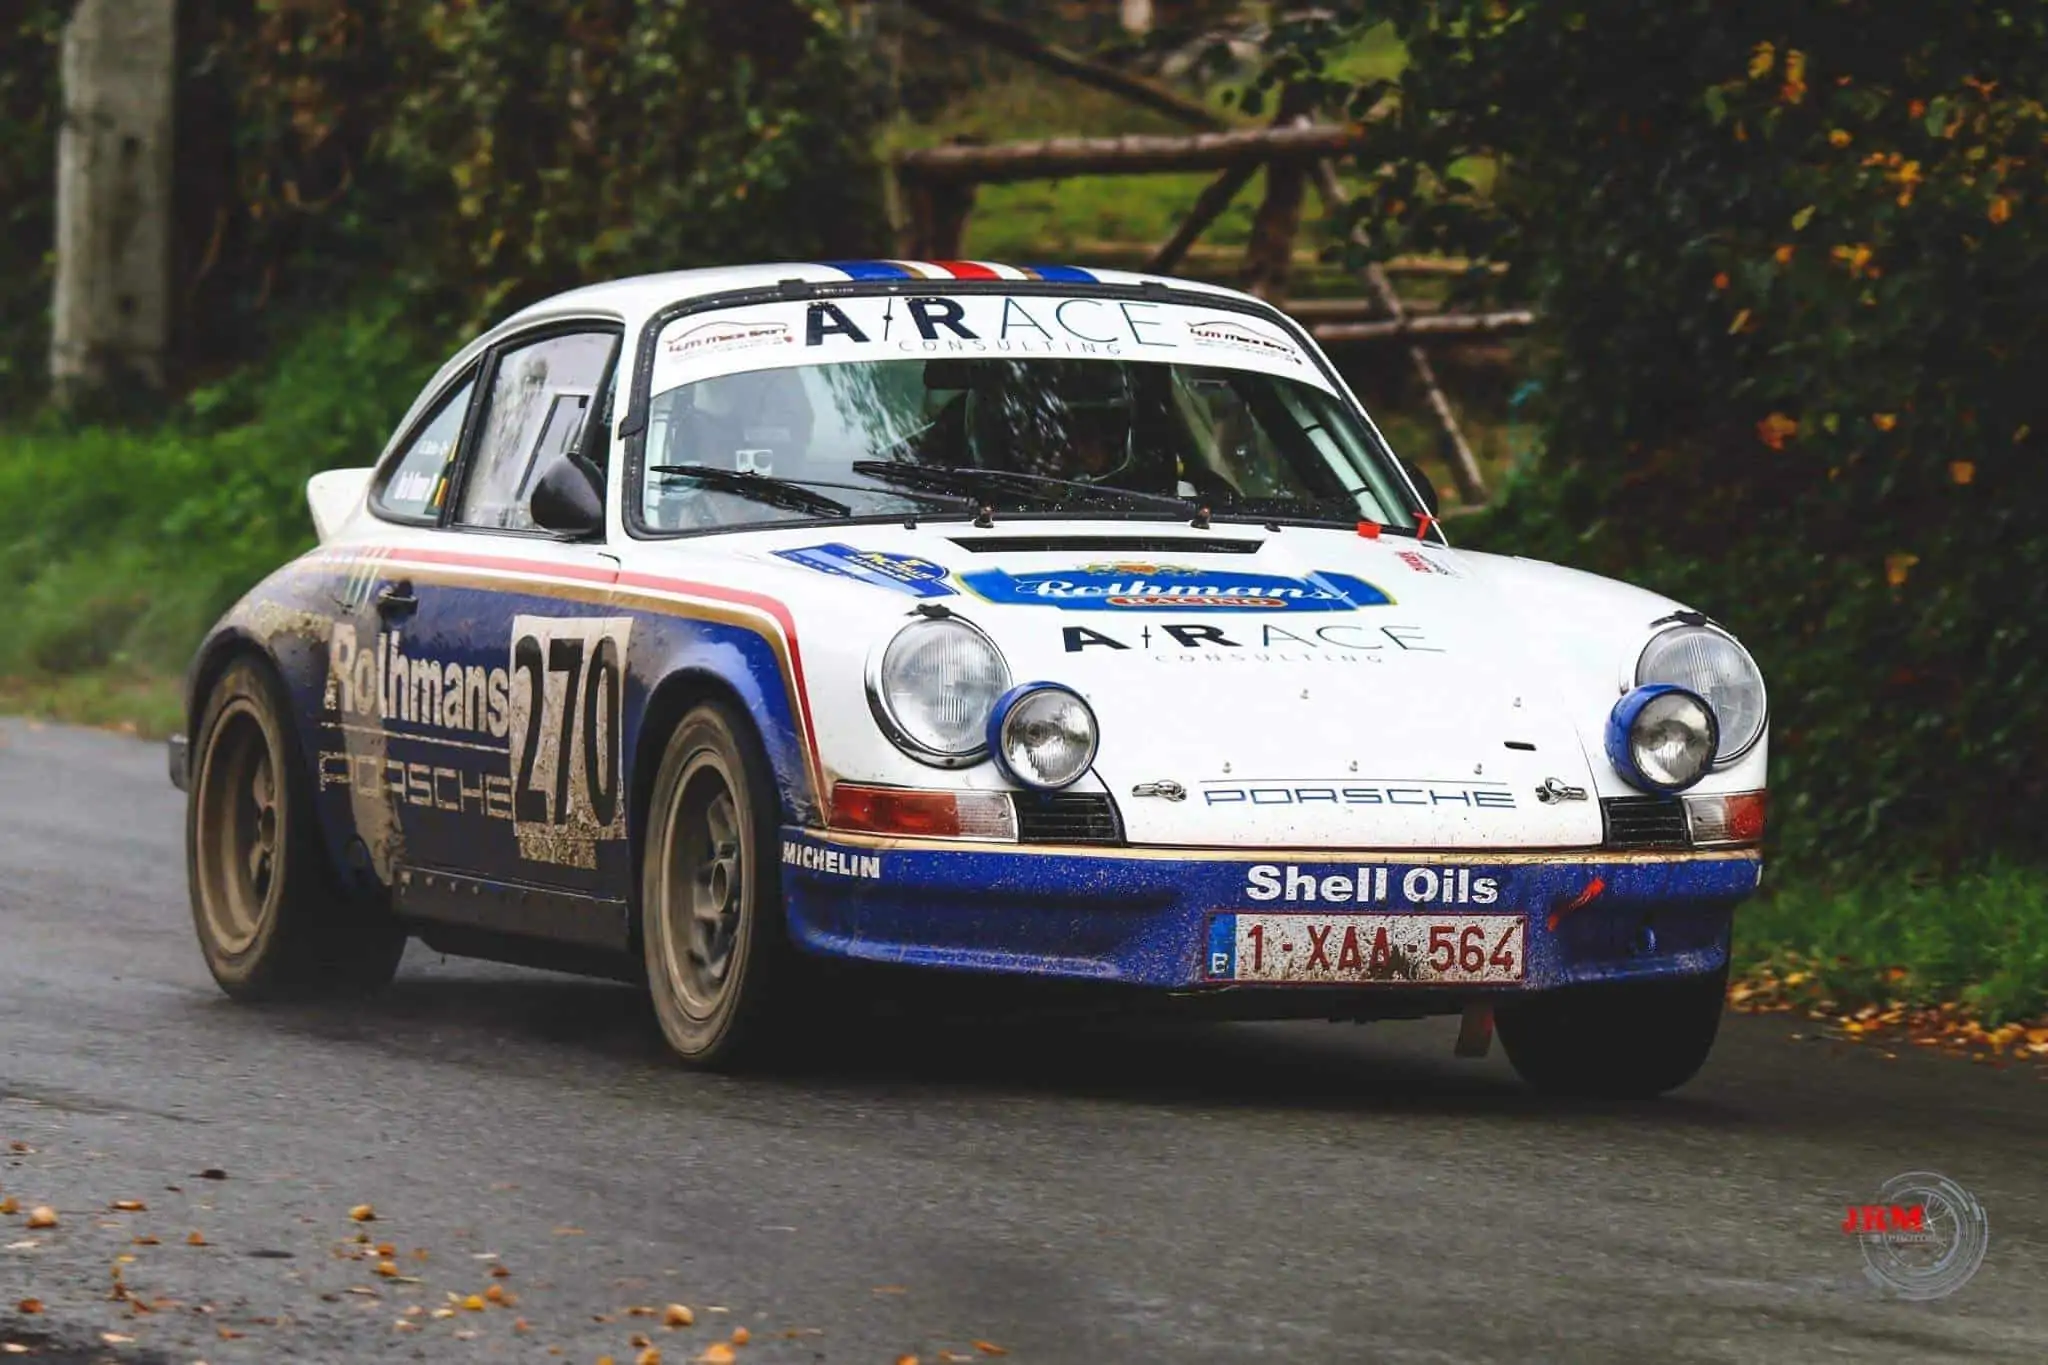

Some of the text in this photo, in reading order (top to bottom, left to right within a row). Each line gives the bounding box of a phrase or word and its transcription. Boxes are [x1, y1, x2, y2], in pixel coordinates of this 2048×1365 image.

[898, 339, 1122, 355] CONSULTING
[1016, 579, 1350, 599] Rothmans
[1154, 654, 1384, 665] CONSULTING
[325, 621, 511, 738] Rothmans
[514, 634, 621, 827] 270
[319, 750, 513, 820] PORSCHE
[1203, 788, 1517, 809] PORSCHE
[782, 841, 881, 879] MICHELIN
[1245, 864, 1499, 904] Shell Oils
[1246, 924, 1516, 973] 1-XAA-564
